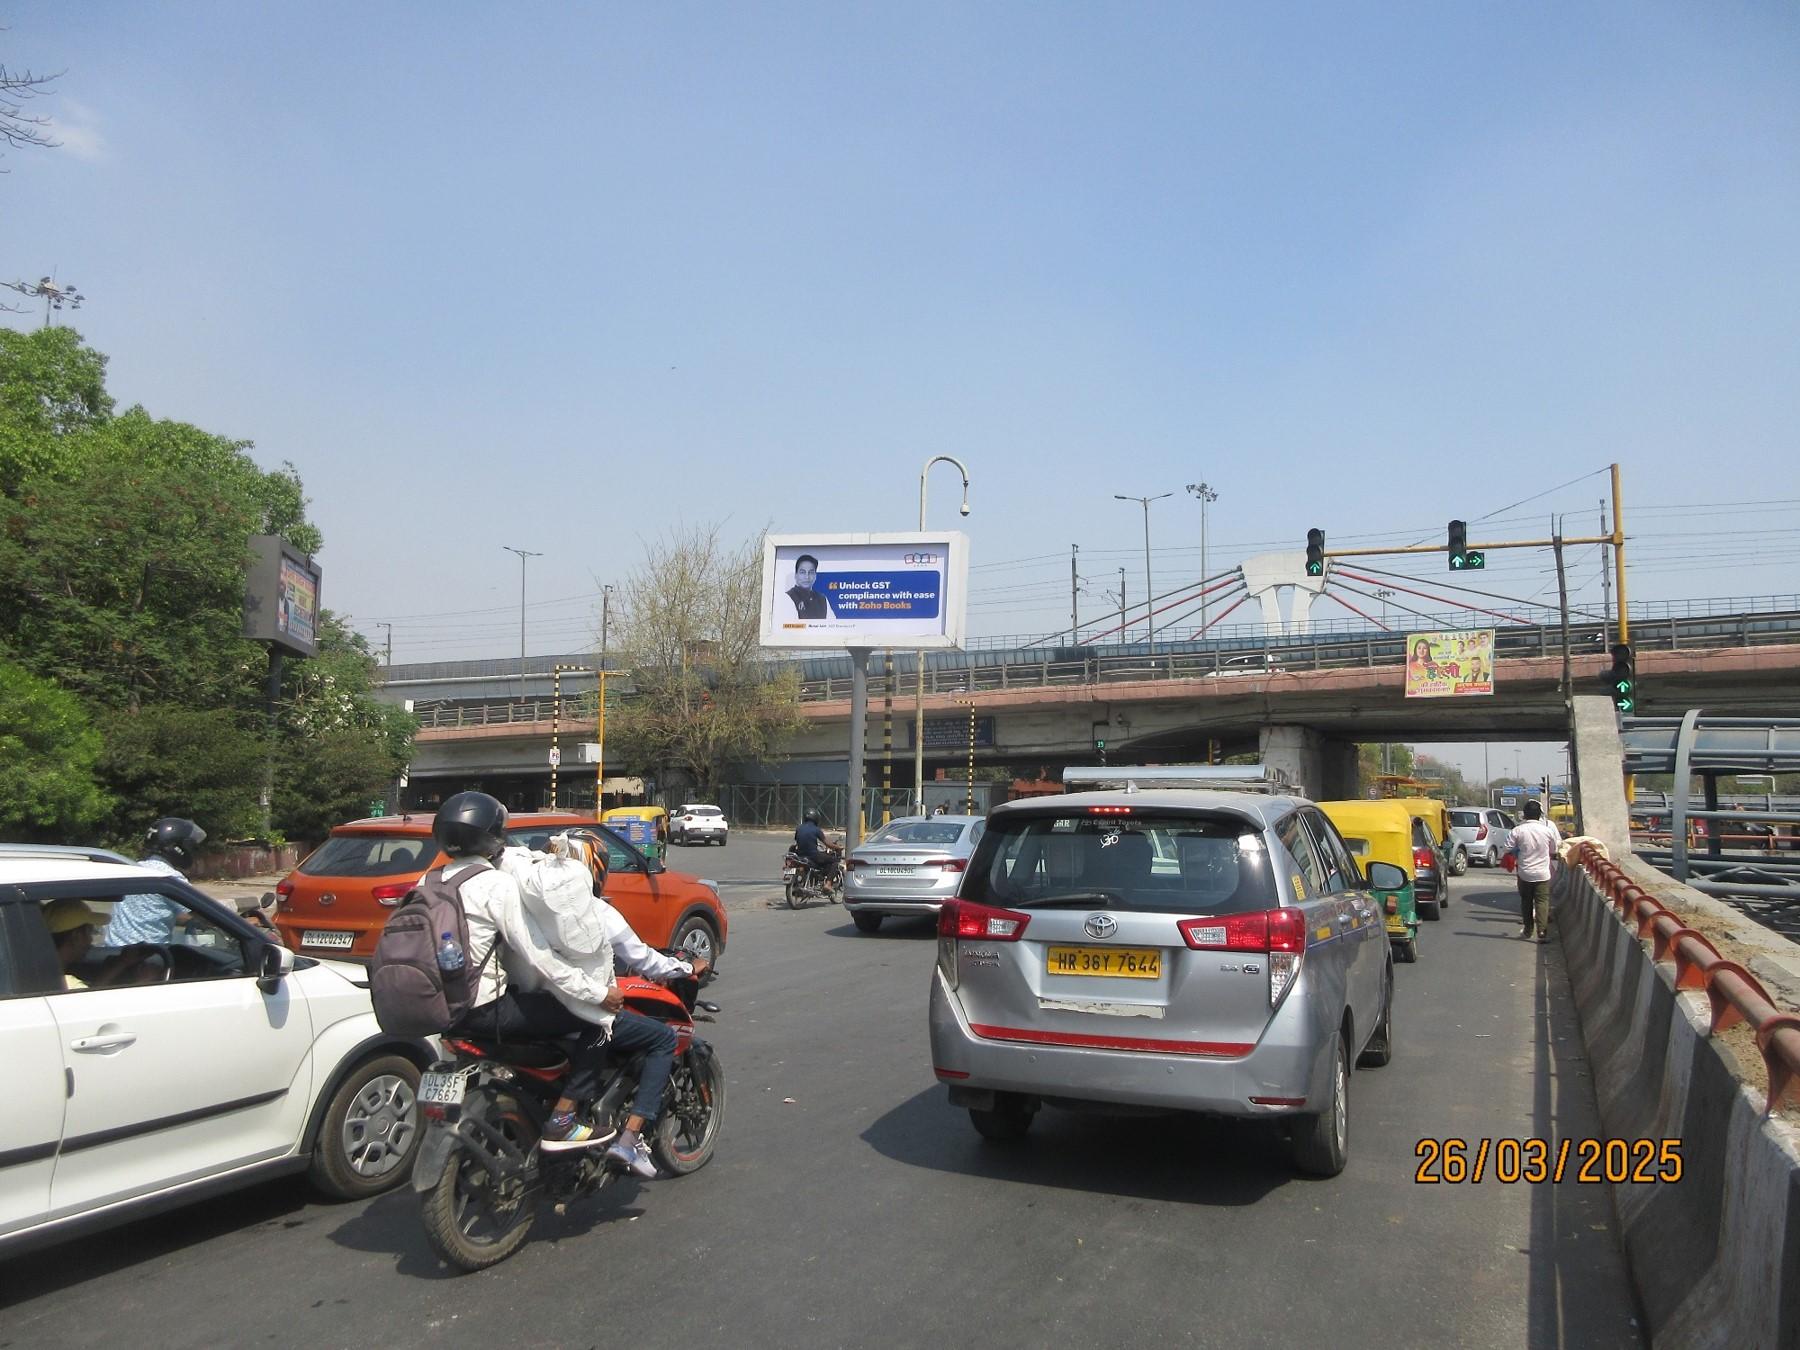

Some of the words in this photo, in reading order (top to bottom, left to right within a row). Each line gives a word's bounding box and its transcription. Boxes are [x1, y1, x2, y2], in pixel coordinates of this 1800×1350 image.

[839, 581, 871, 590] Unlock
[871, 581, 891, 590] GST
[838, 591, 891, 601] compliance
[891, 591, 913, 600] with
[913, 592, 936, 600] ease
[838, 601, 858, 610] with
[859, 601, 882, 610] Zoho
[883, 601, 912, 610] Books
[1058, 953, 1077, 970] HR
[1117, 955, 1157, 973] 7644
[425, 1088, 458, 1102] C7667
